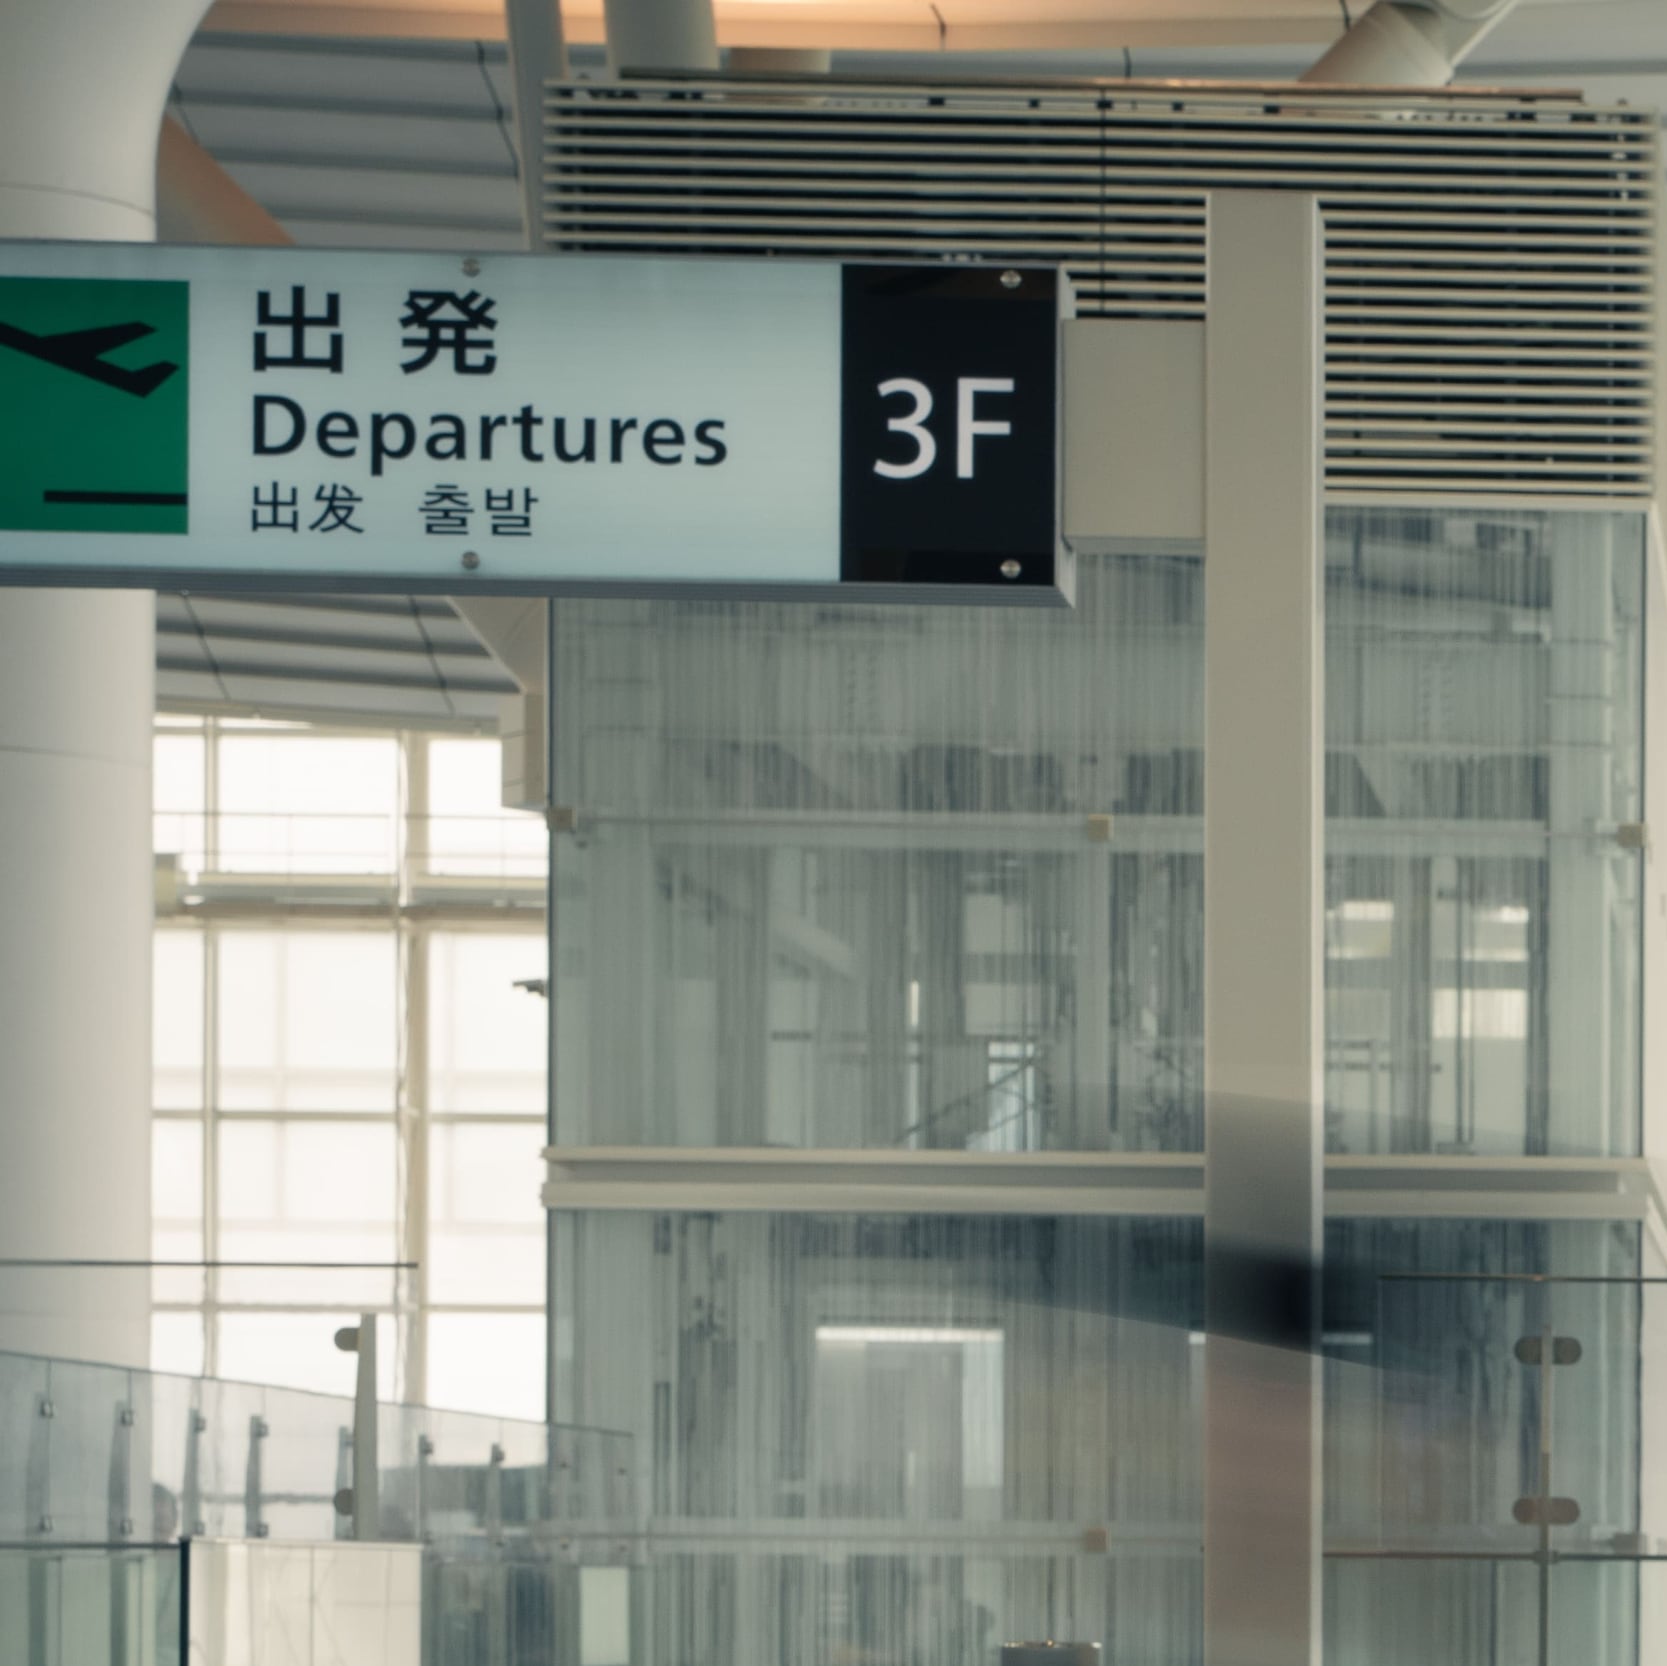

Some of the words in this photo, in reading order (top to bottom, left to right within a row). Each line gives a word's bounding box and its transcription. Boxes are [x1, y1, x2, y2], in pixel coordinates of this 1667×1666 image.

[252, 284, 498, 376] 出発
[251, 394, 728, 478] Departures
[872, 376, 1015, 480] 3F
[250, 481, 365, 535] 出发
[418, 483, 540, 537] 출발
